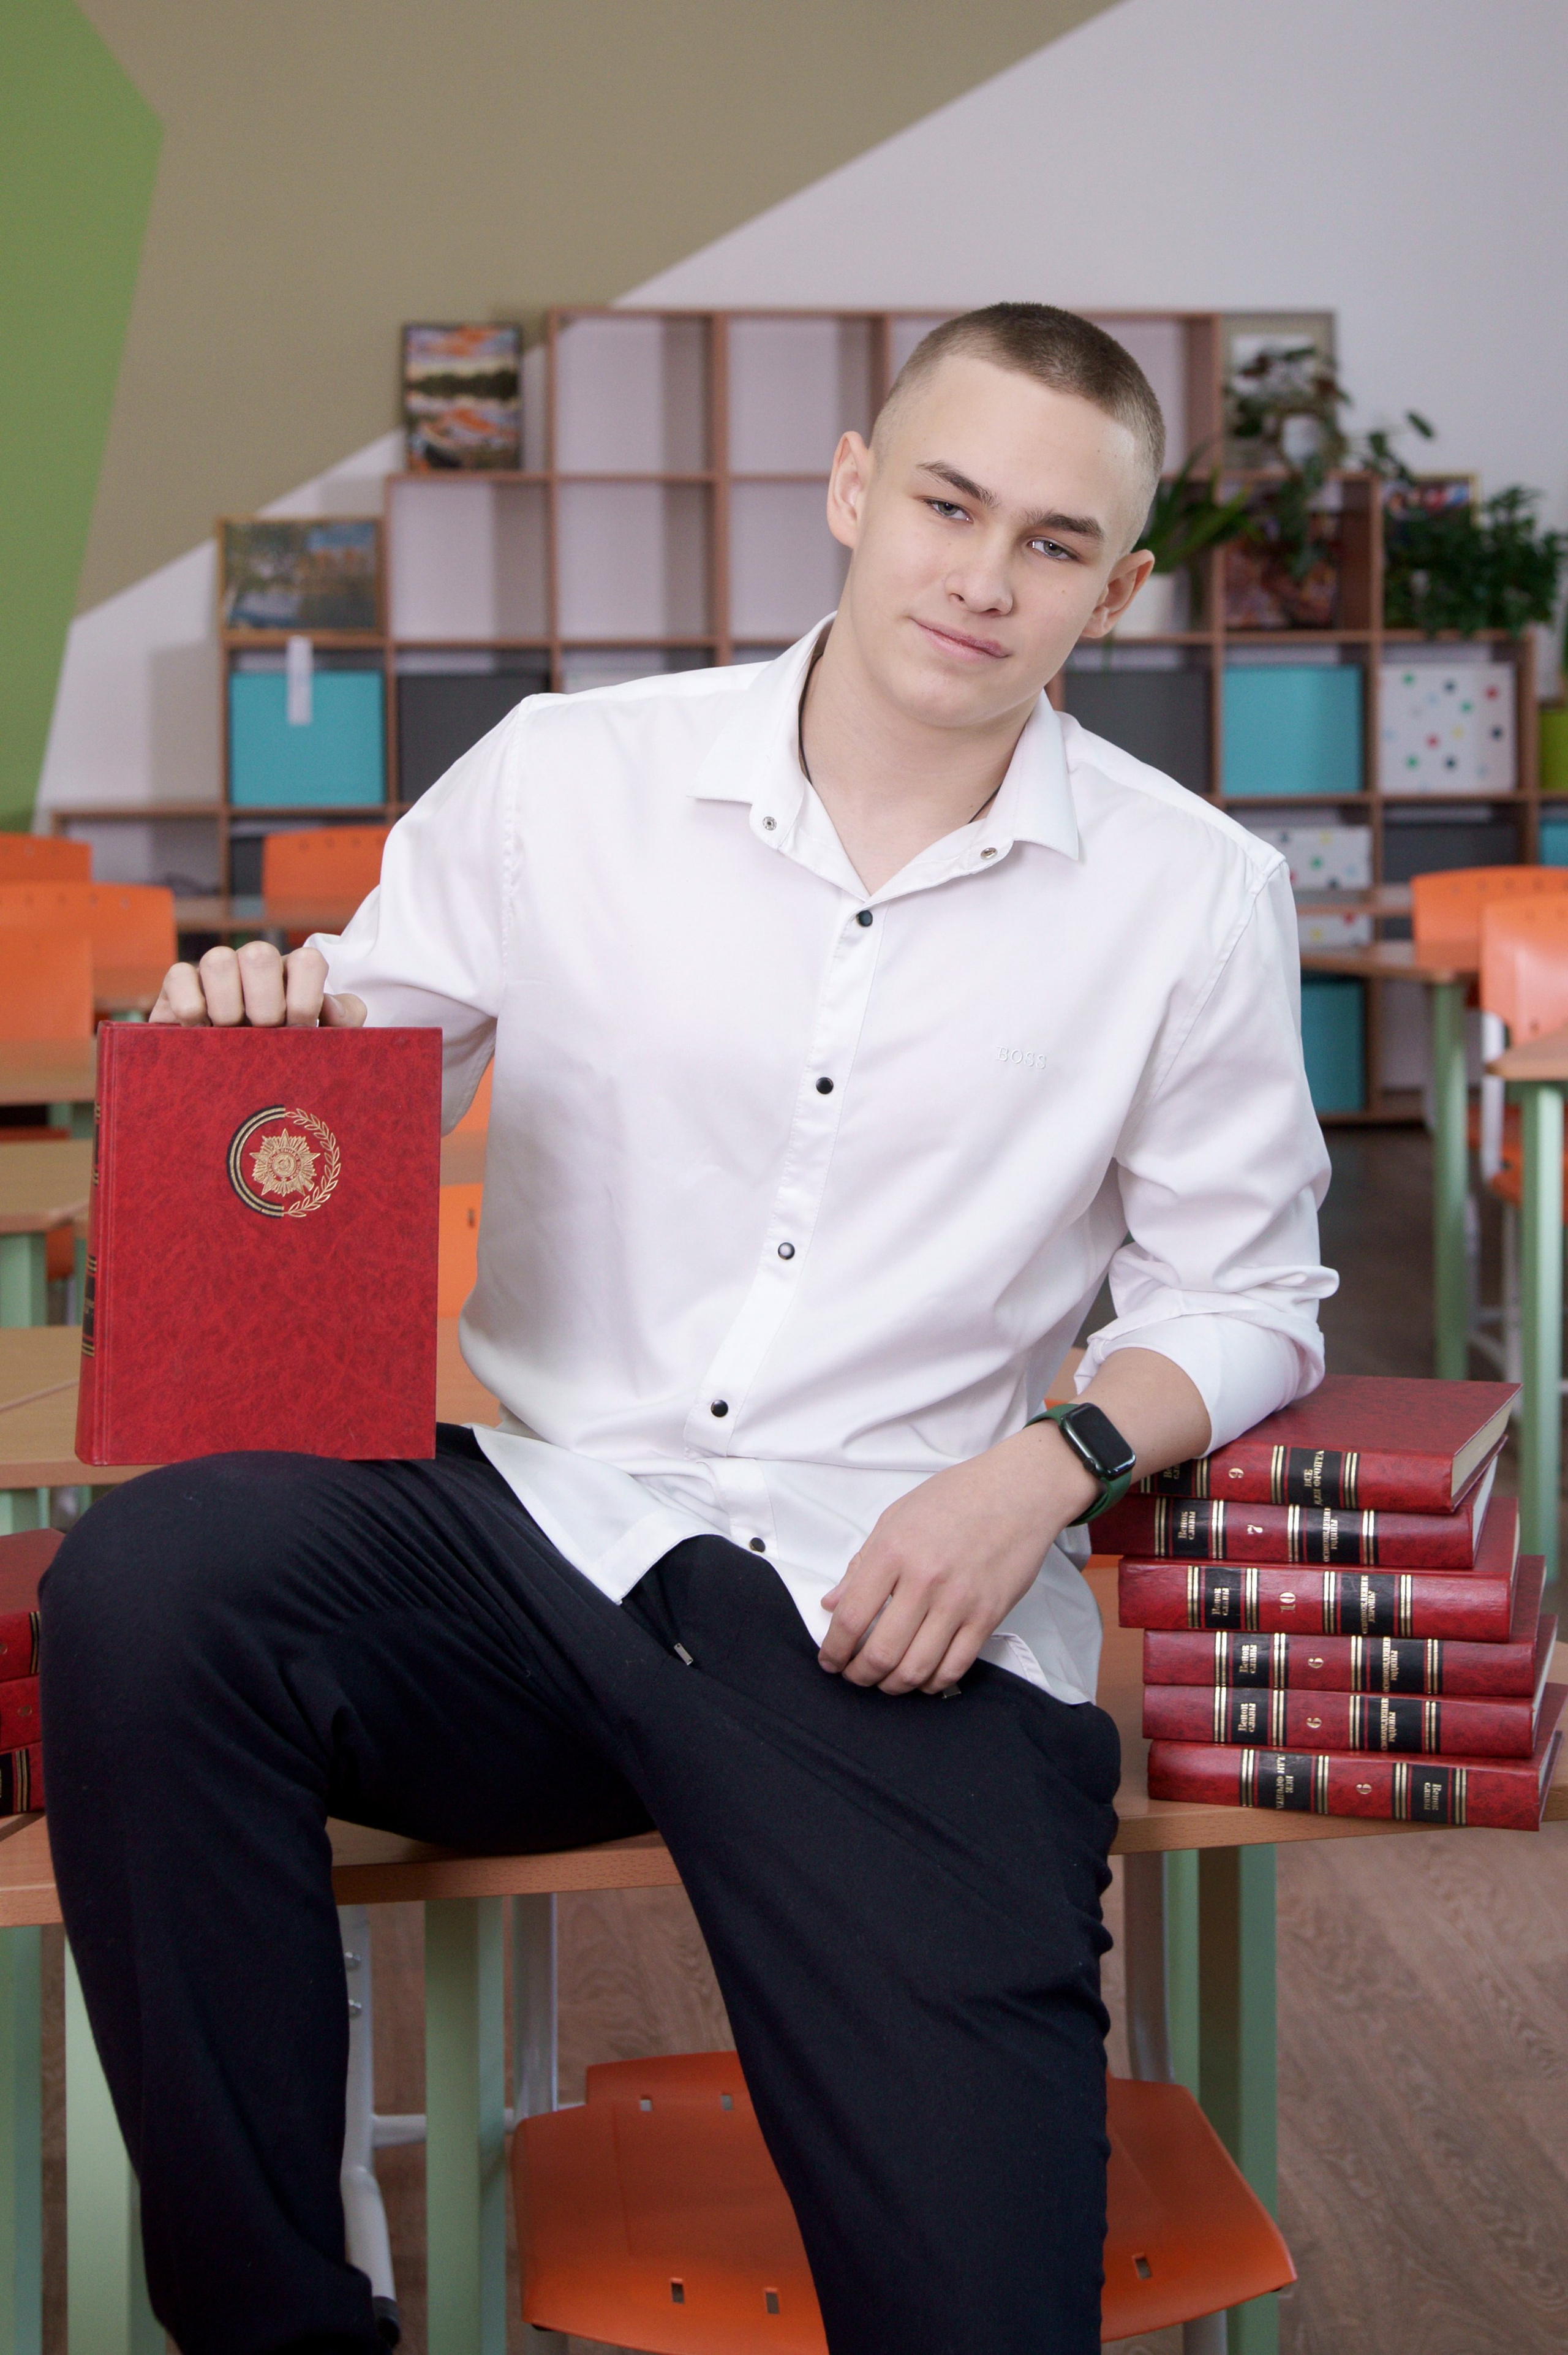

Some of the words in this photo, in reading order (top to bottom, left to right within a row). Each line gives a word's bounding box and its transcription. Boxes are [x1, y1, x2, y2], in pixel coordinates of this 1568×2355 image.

[995, 1045, 1047, 1069] BOSS
[1228, 1467, 1244, 1478] 9
[1303, 1469, 1313, 1487] ВСЕ
[1313, 1450, 1325, 1487] ФРОНТА
[1313, 1489, 1323, 1507] ДЛЯ
[1178, 1511, 1188, 1540] Венок
[1247, 1524, 1264, 1535] 7
[1212, 1587, 1221, 1615] Венок
[1279, 1592, 1296, 1613] 10
[1239, 1644, 1250, 1673] Венок
[1308, 1657, 1324, 1669] 6
[1238, 1703, 1248, 1732] Венок
[1306, 1717, 1322, 1729] 6
[1276, 1753, 1286, 1774] ДЛЯ
[1276, 1775, 1285, 1809] ФРОНТА
[1285, 1775, 1294, 1793] ВСЕ
[1431, 1783, 1442, 1811] Венок
